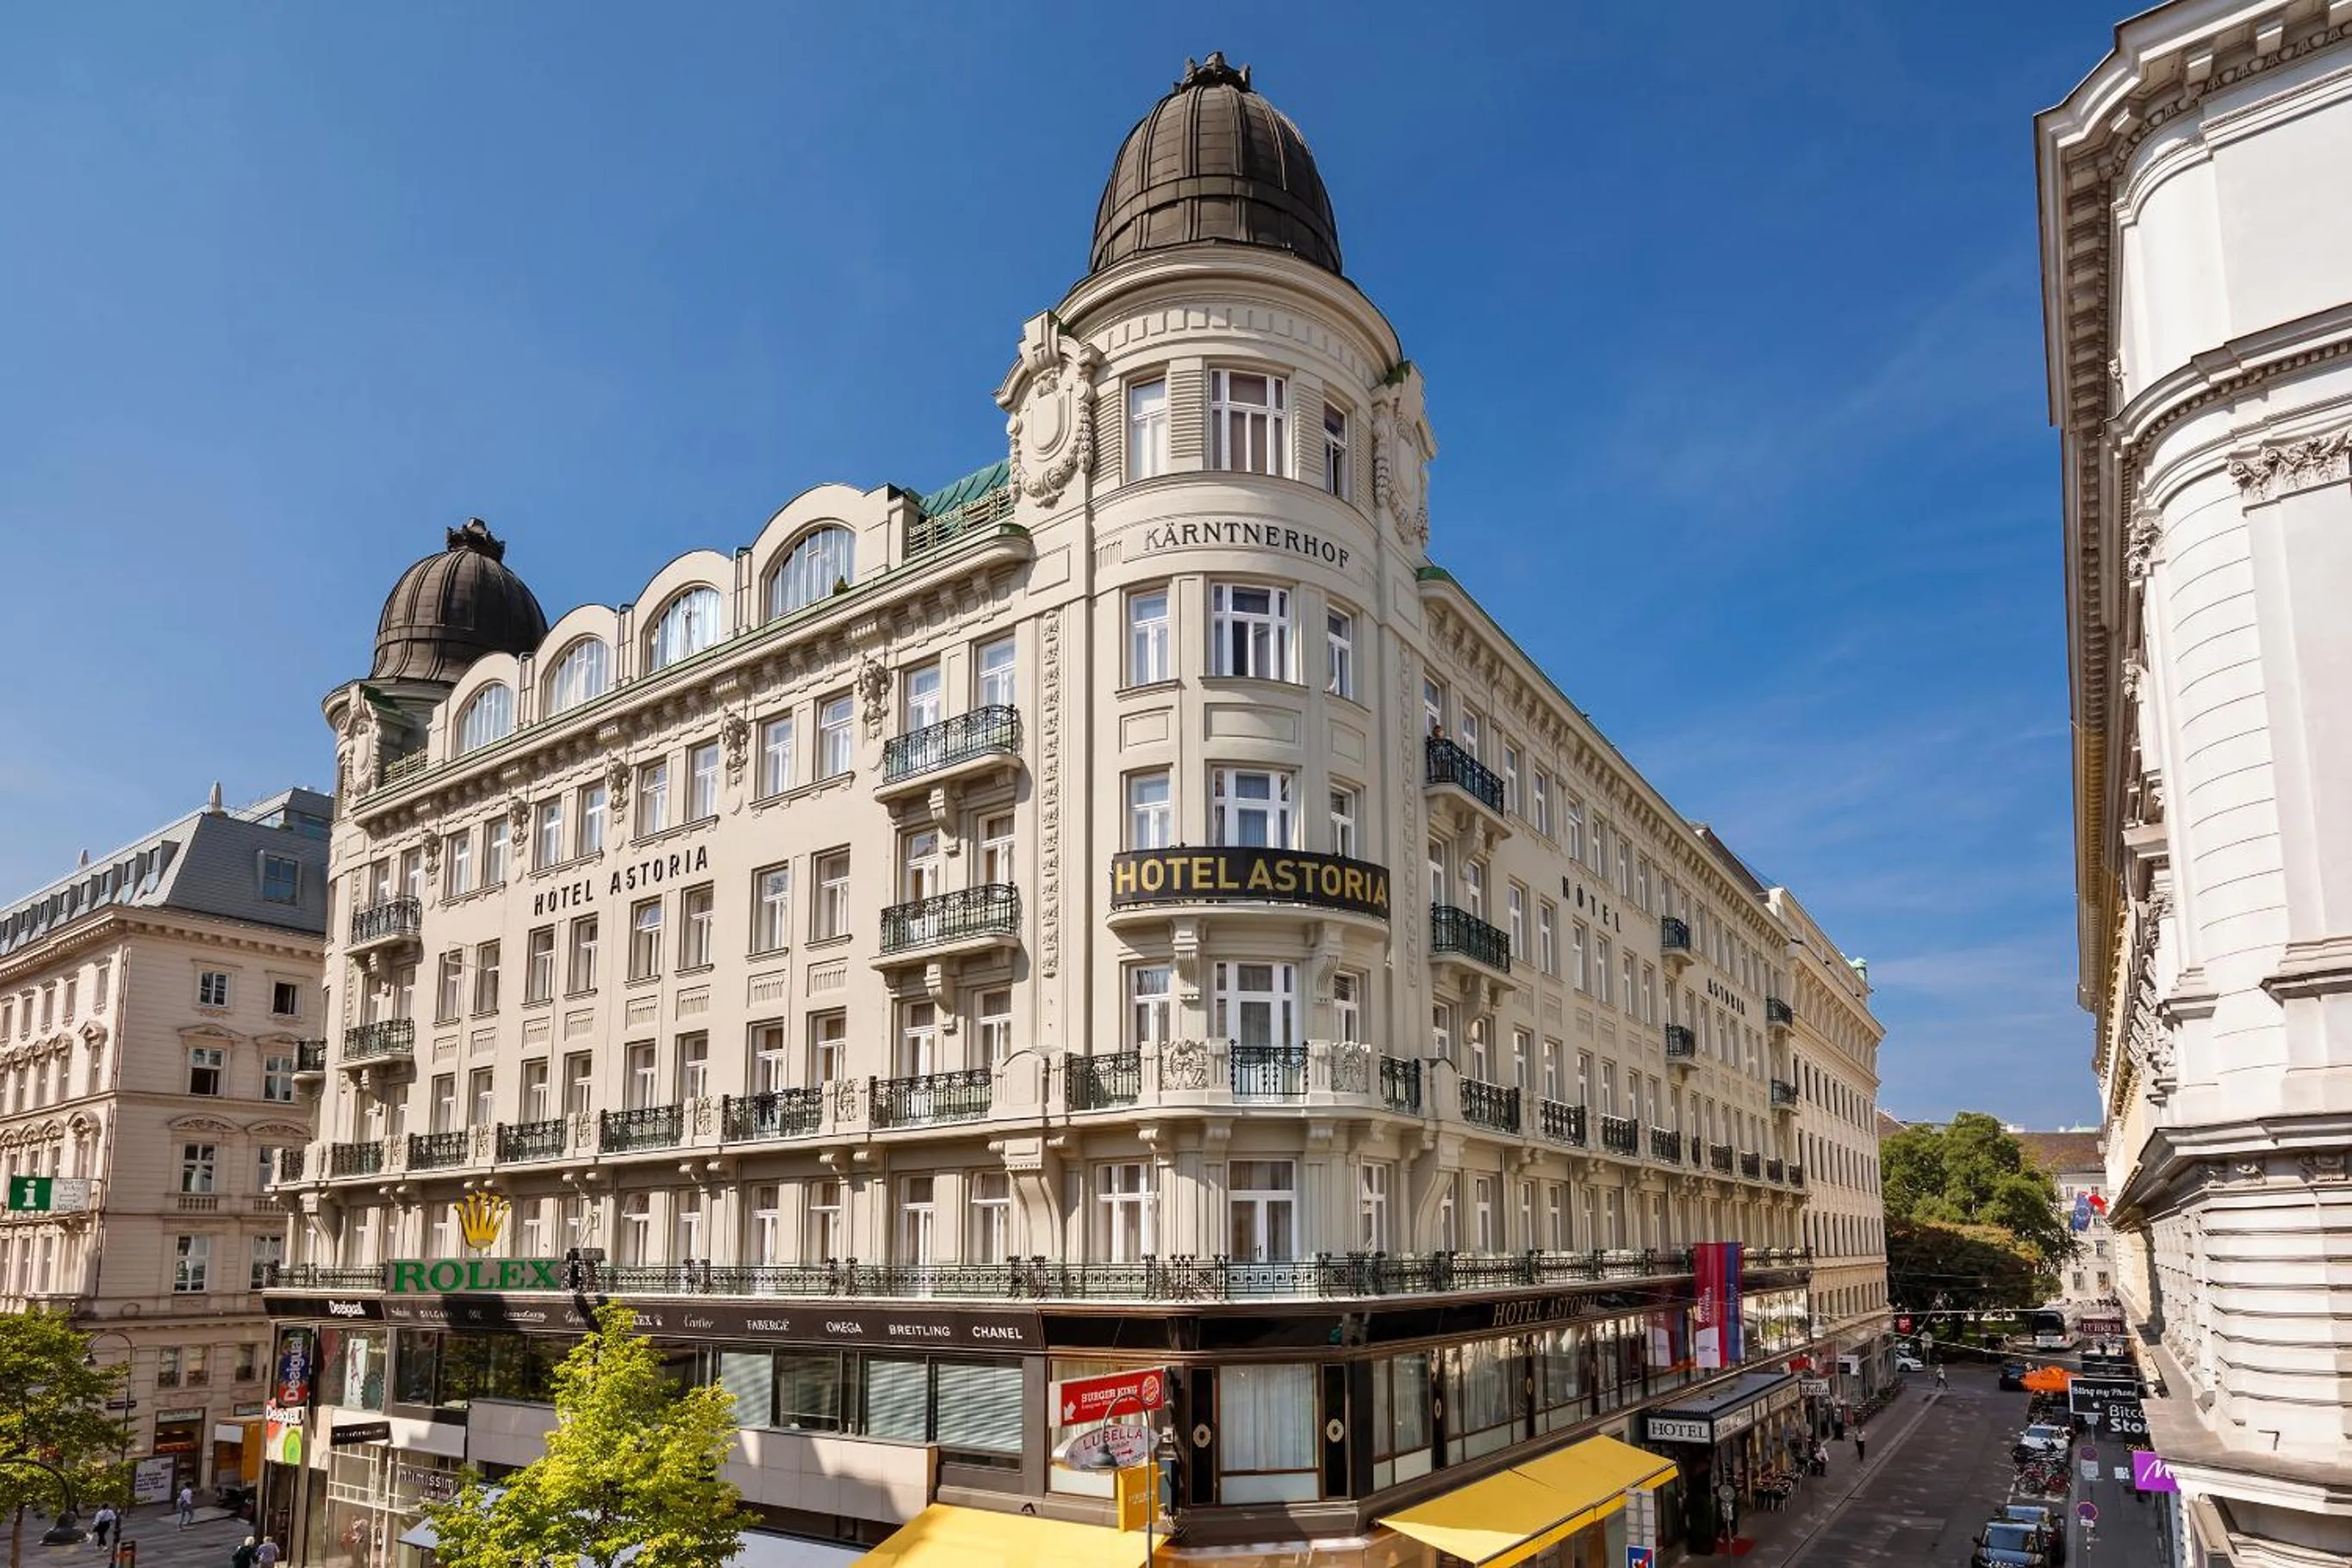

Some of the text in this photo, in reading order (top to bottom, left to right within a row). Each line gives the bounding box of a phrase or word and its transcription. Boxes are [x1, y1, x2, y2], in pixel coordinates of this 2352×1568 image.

[1144, 521, 1350, 568] KÄRNTNERHOF
[609, 845, 708, 895] ASTORIA
[1115, 856, 1388, 909] HOTEL ASTORIA
[1707, 978, 1746, 1017] ASTORIA
[390, 1259, 560, 1293] ROLEX
[1491, 1299, 1543, 1327] HOTEL
[825, 1321, 863, 1335] OMEGA
[888, 1323, 951, 1337] BREITLING
[972, 1325, 1024, 1340] CHANEL
[1081, 1388, 1116, 1403] BURGER
[1117, 1385, 1138, 1397] KING
[1083, 1429, 1142, 1450] LUBELLA
[1652, 1422, 1708, 1438] HOTEL
